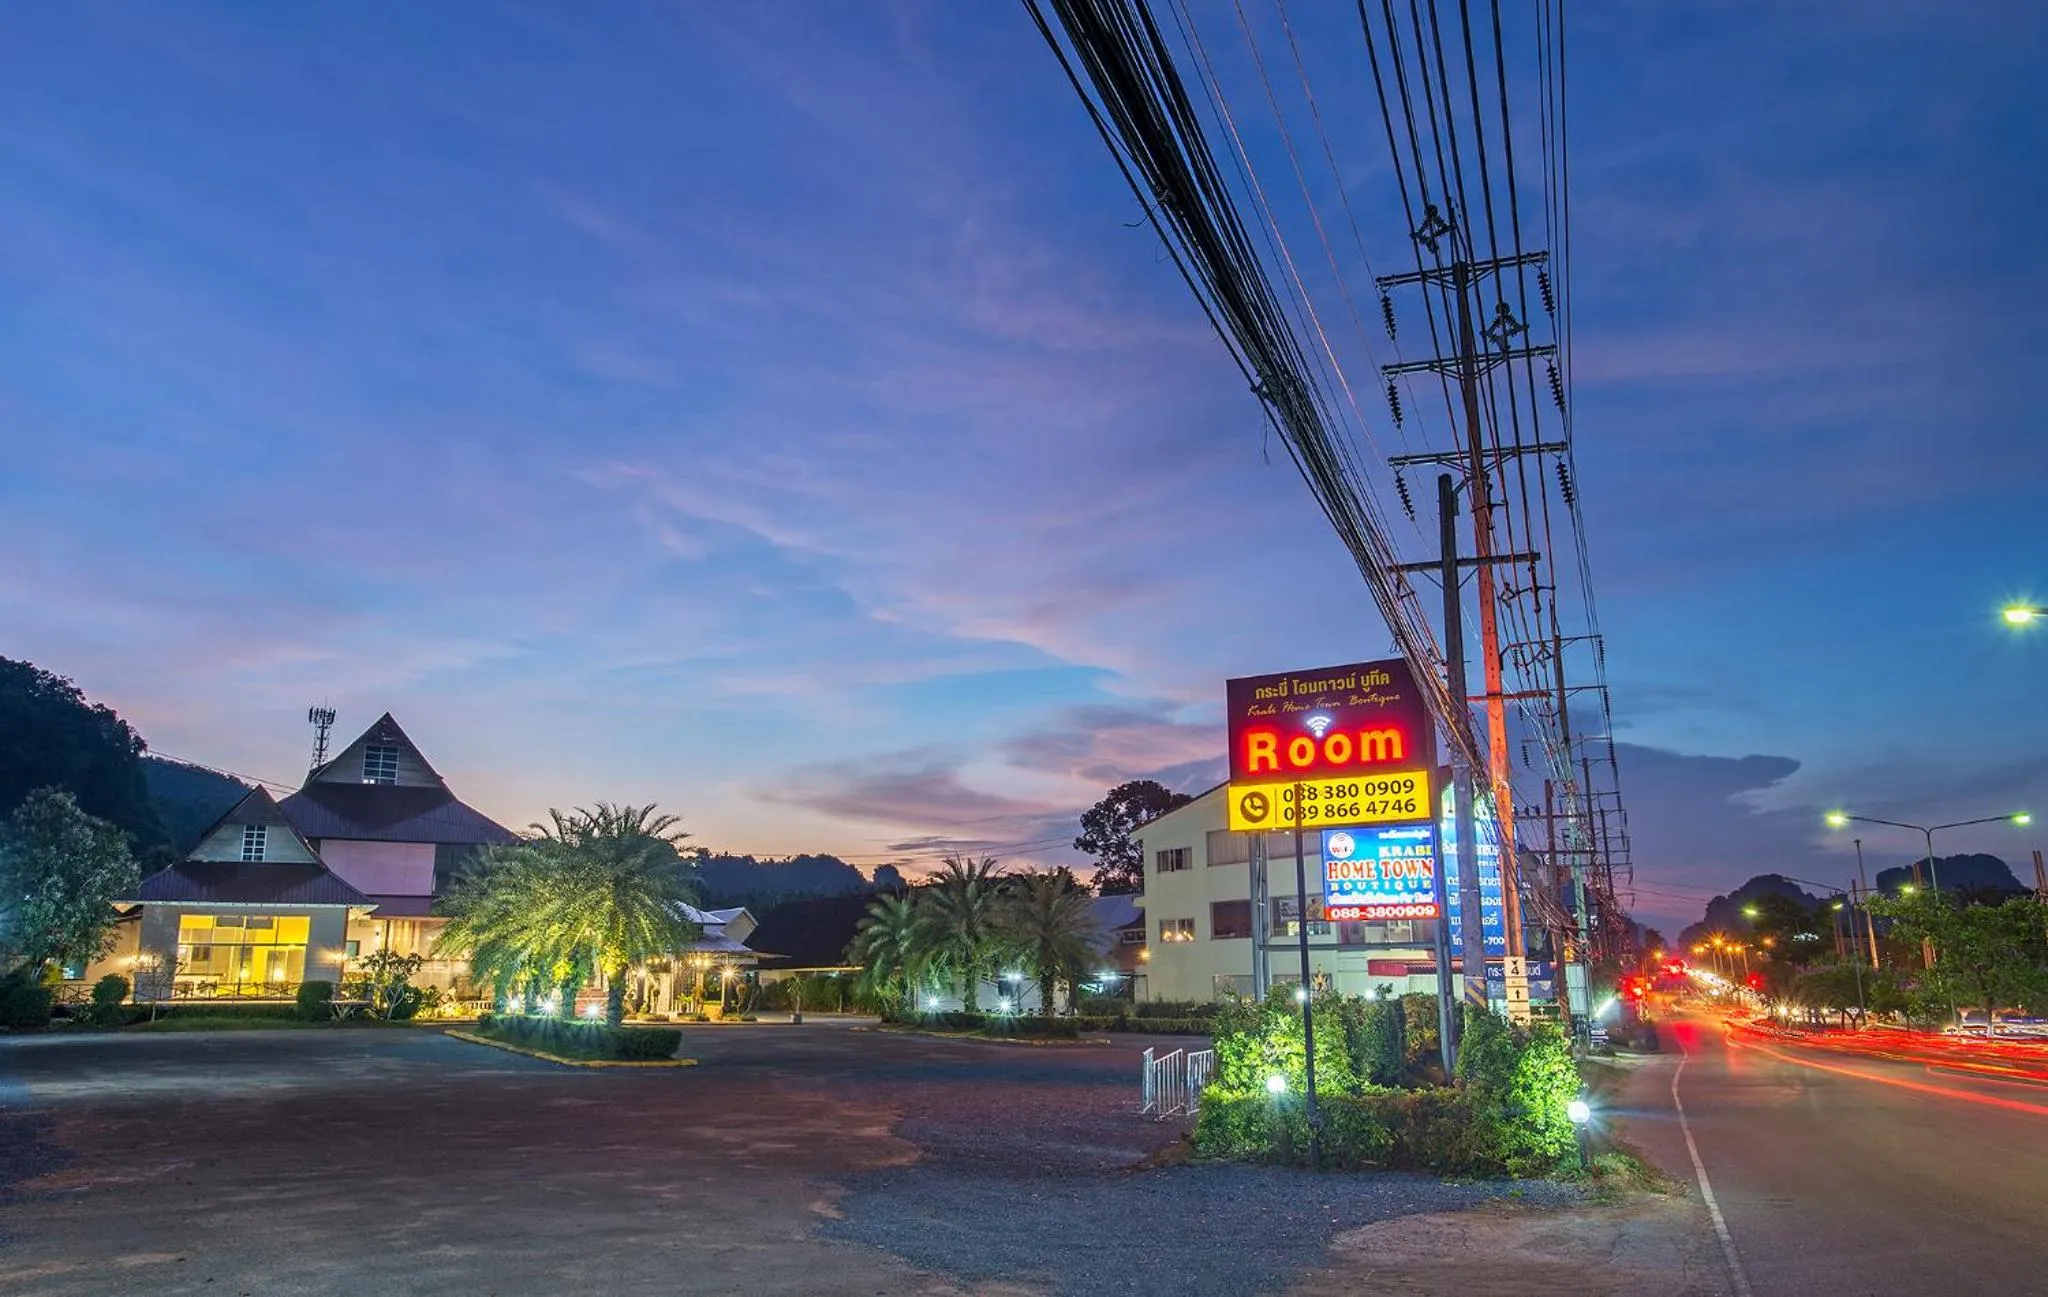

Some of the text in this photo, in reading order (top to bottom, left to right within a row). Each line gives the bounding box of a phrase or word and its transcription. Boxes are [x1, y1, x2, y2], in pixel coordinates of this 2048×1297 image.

[1255, 677, 1288, 700] กระบี่
[1293, 673, 1356, 695] โฮมทาวน์
[1282, 701, 1311, 713] Home
[1314, 697, 1341, 709] Town
[1348, 693, 1400, 708] Boutique
[1247, 728, 1404, 771] Room
[1324, 783, 1359, 799] 380
[1365, 779, 1415, 796] 0909
[1325, 803, 1360, 818] 866
[1366, 798, 1417, 815] 4746
[1379, 845, 1433, 857] KRABI
[1327, 858, 1434, 881] HOME TOWN
[1331, 880, 1432, 891] BOUTIQUE
[1331, 904, 1436, 919] 088-3800909
